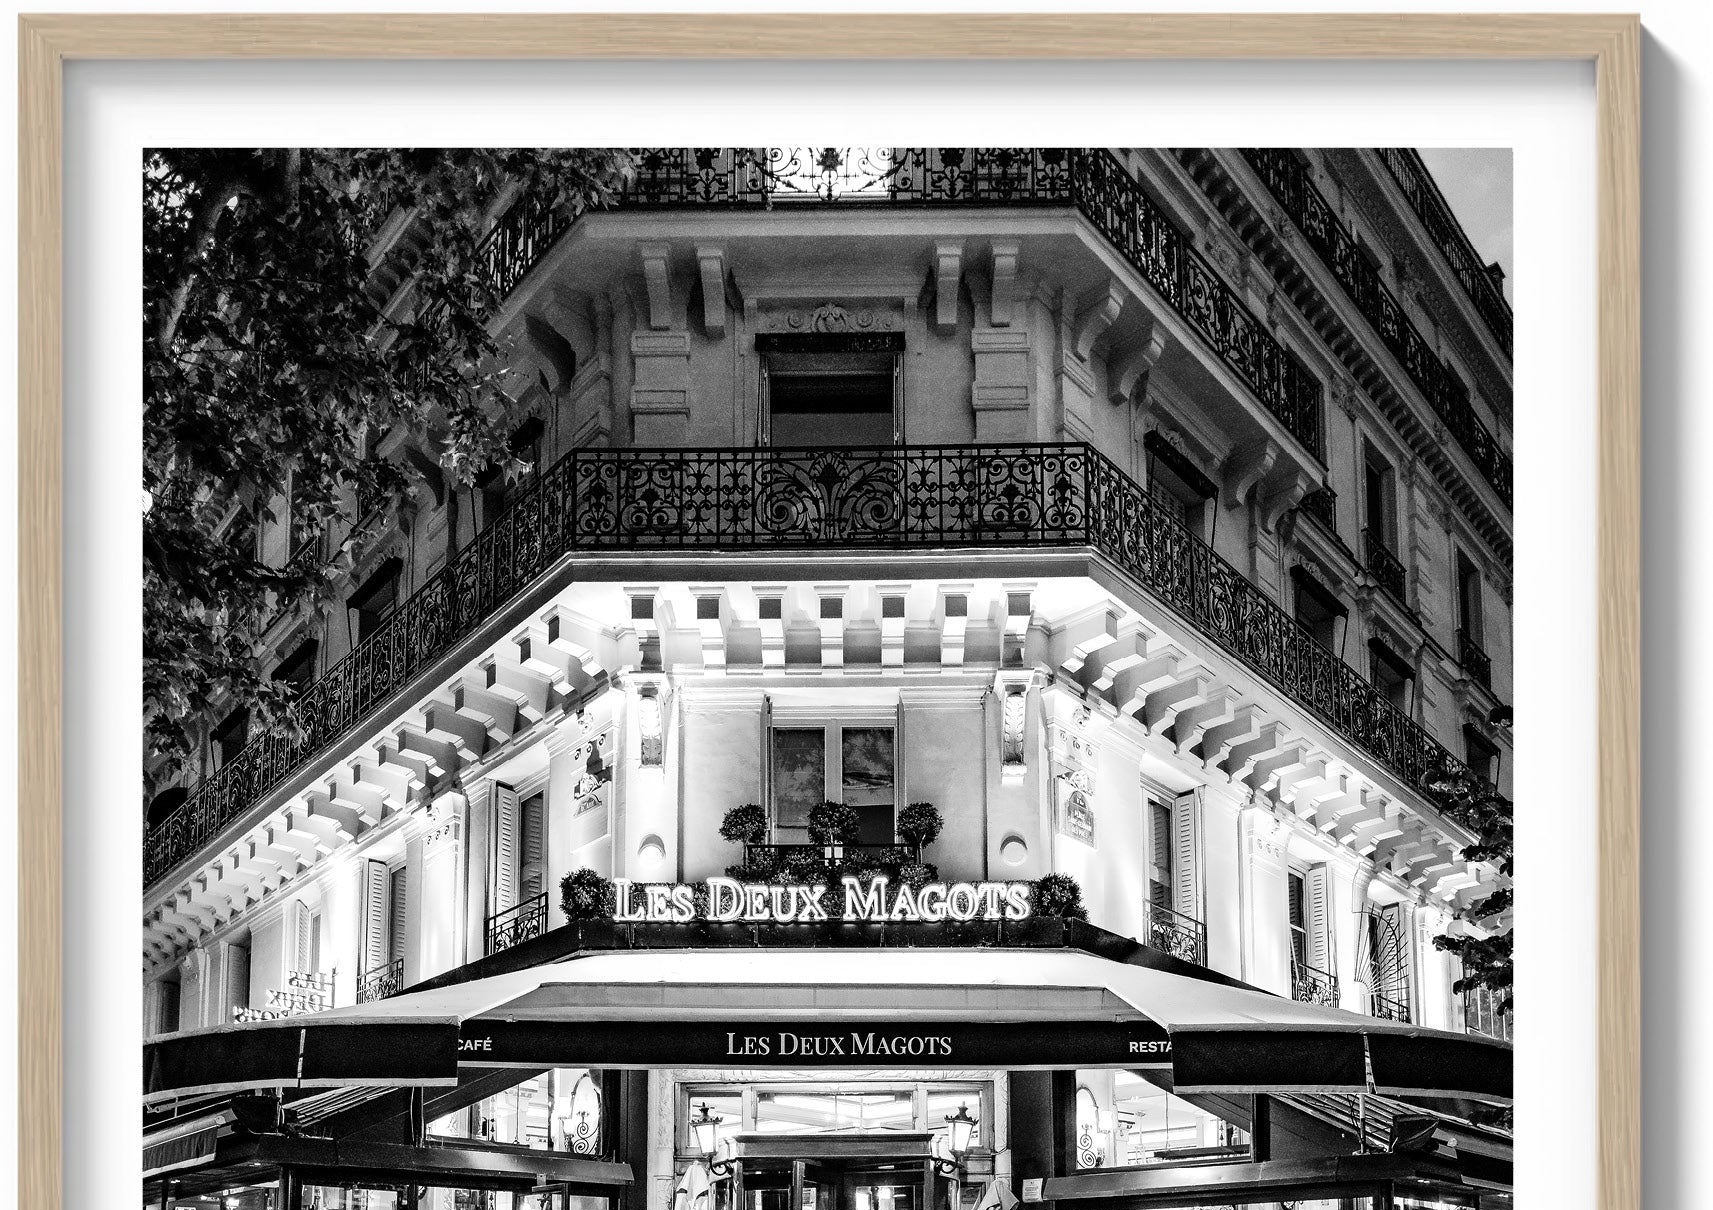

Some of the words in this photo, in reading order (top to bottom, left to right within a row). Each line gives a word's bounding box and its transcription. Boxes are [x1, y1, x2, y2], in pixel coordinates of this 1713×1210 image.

[613, 877, 695, 922] LES
[706, 876, 829, 922] DEUX
[842, 876, 1031, 922] MAGOTS
[457, 1036, 493, 1051] CAFÉ
[726, 1032, 770, 1056] LES
[778, 1032, 845, 1056] DEUX
[850, 1032, 953, 1056] MAGOTS
